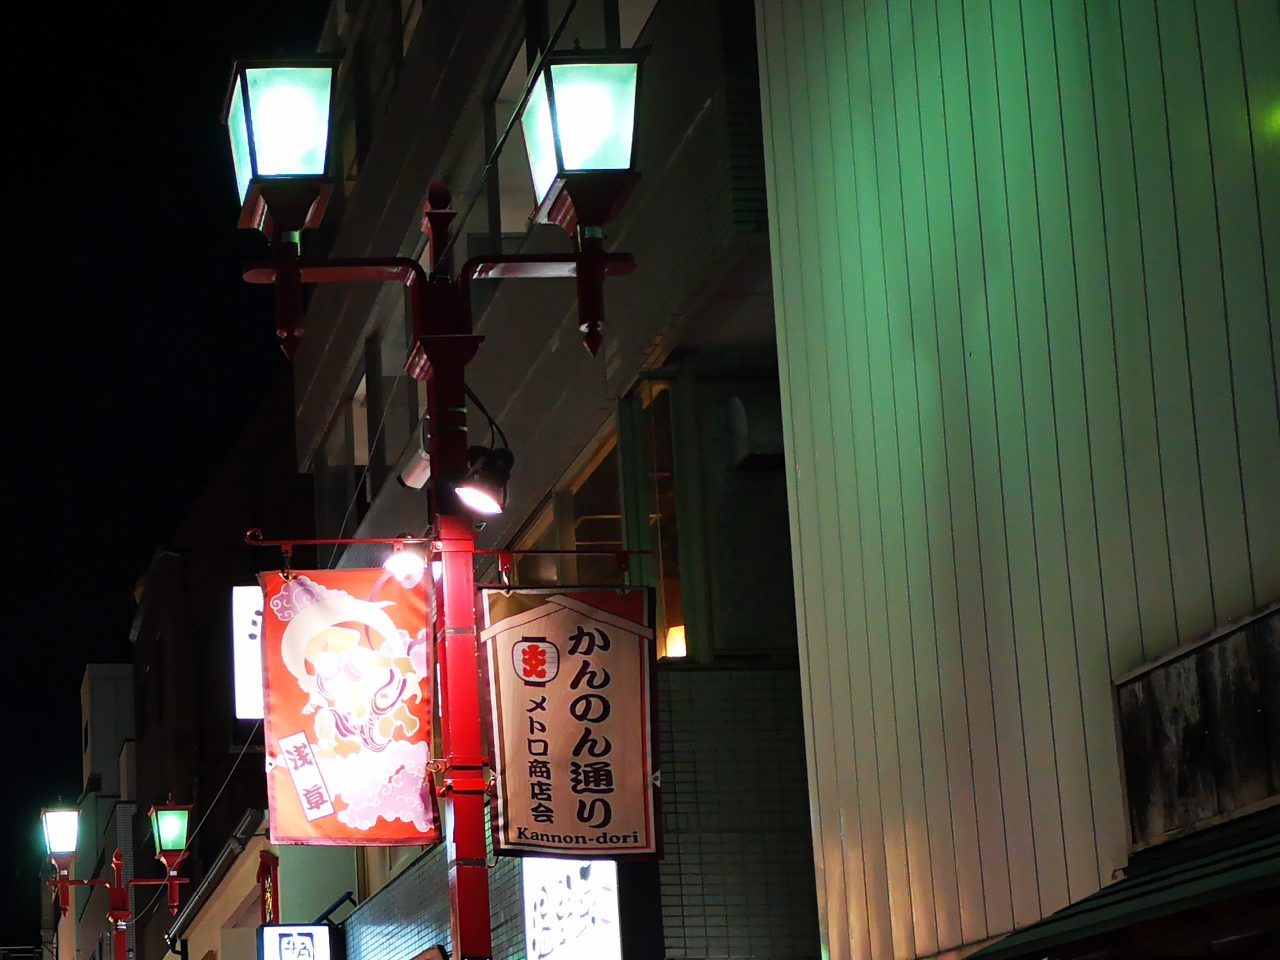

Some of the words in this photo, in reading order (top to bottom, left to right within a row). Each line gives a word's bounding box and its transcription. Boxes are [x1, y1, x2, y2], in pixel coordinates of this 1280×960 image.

[525, 696, 555, 826] メトロ商店会
[568, 624, 614, 829] かんのん通り
[285, 742, 329, 811] 浅草
[516, 826, 639, 845] Kannon-dori
